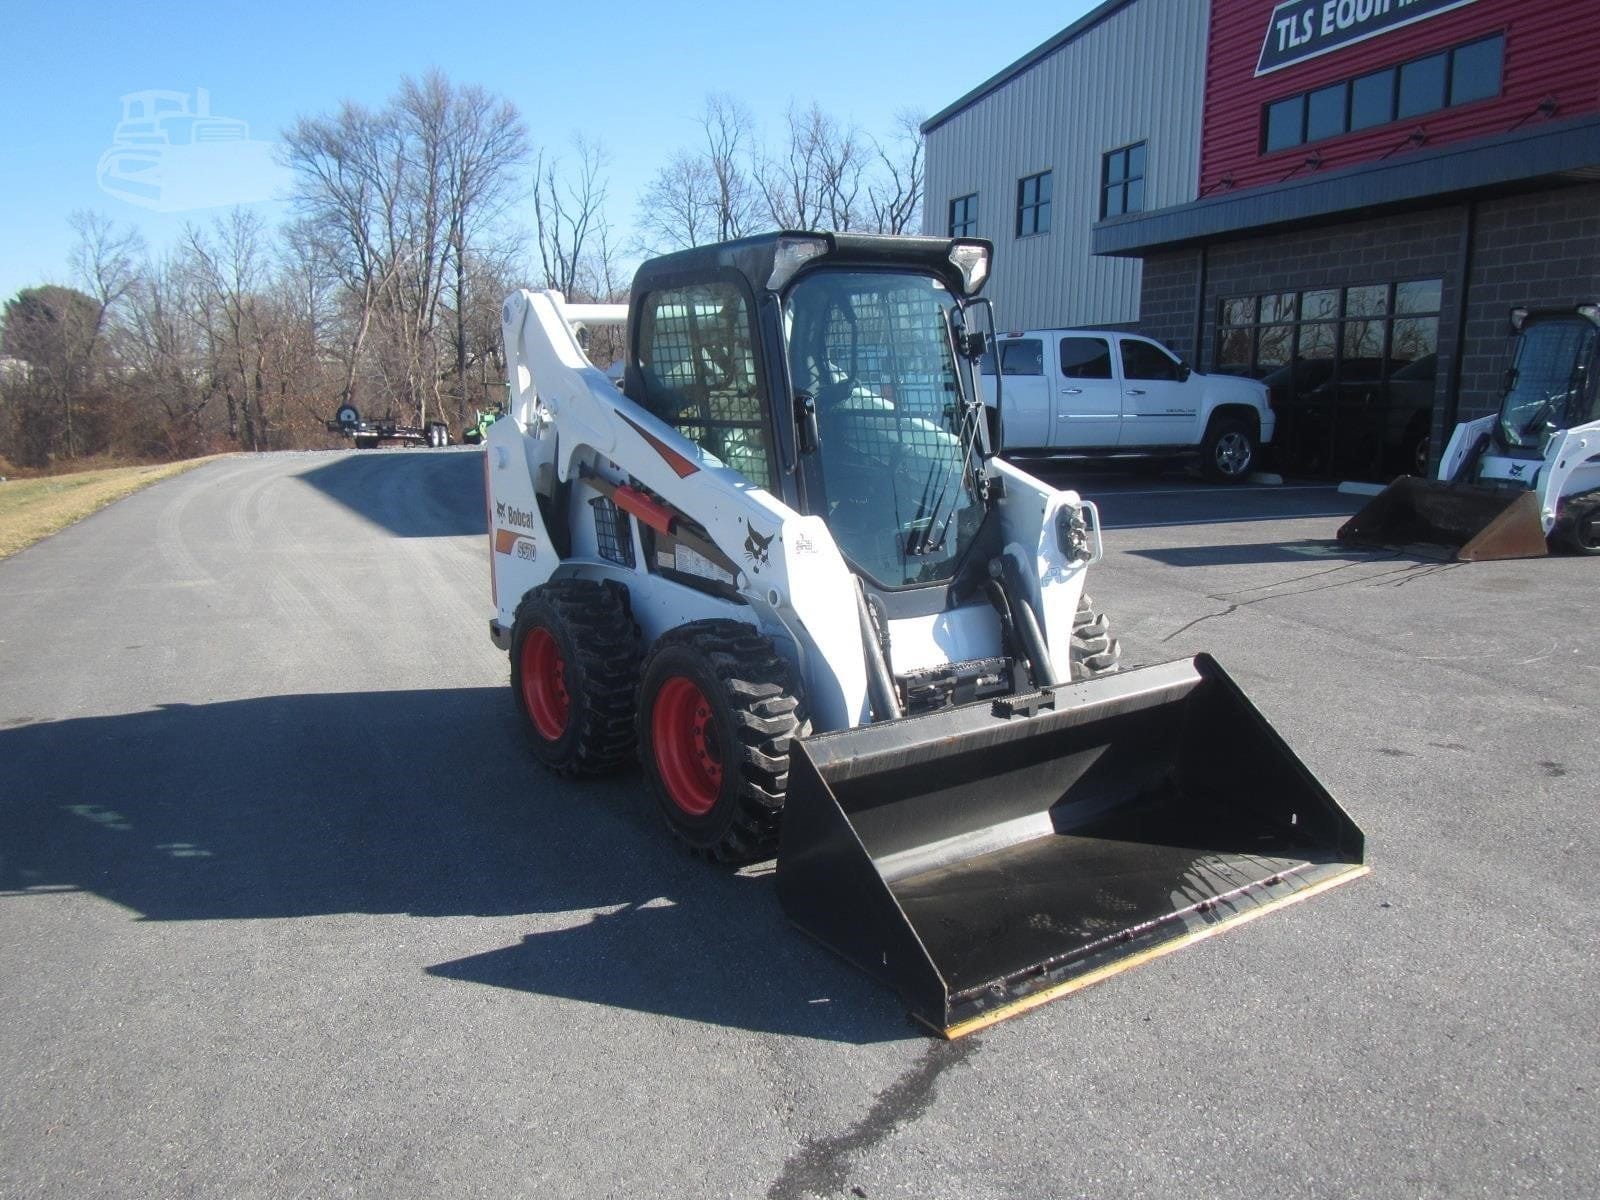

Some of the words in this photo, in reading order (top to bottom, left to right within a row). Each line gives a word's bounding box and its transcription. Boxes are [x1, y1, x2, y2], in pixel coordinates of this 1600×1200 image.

[1276, 8, 1314, 52] TLS
[1320, 0, 1418, 37] EQU
[507, 505, 534, 529] Bobcat
